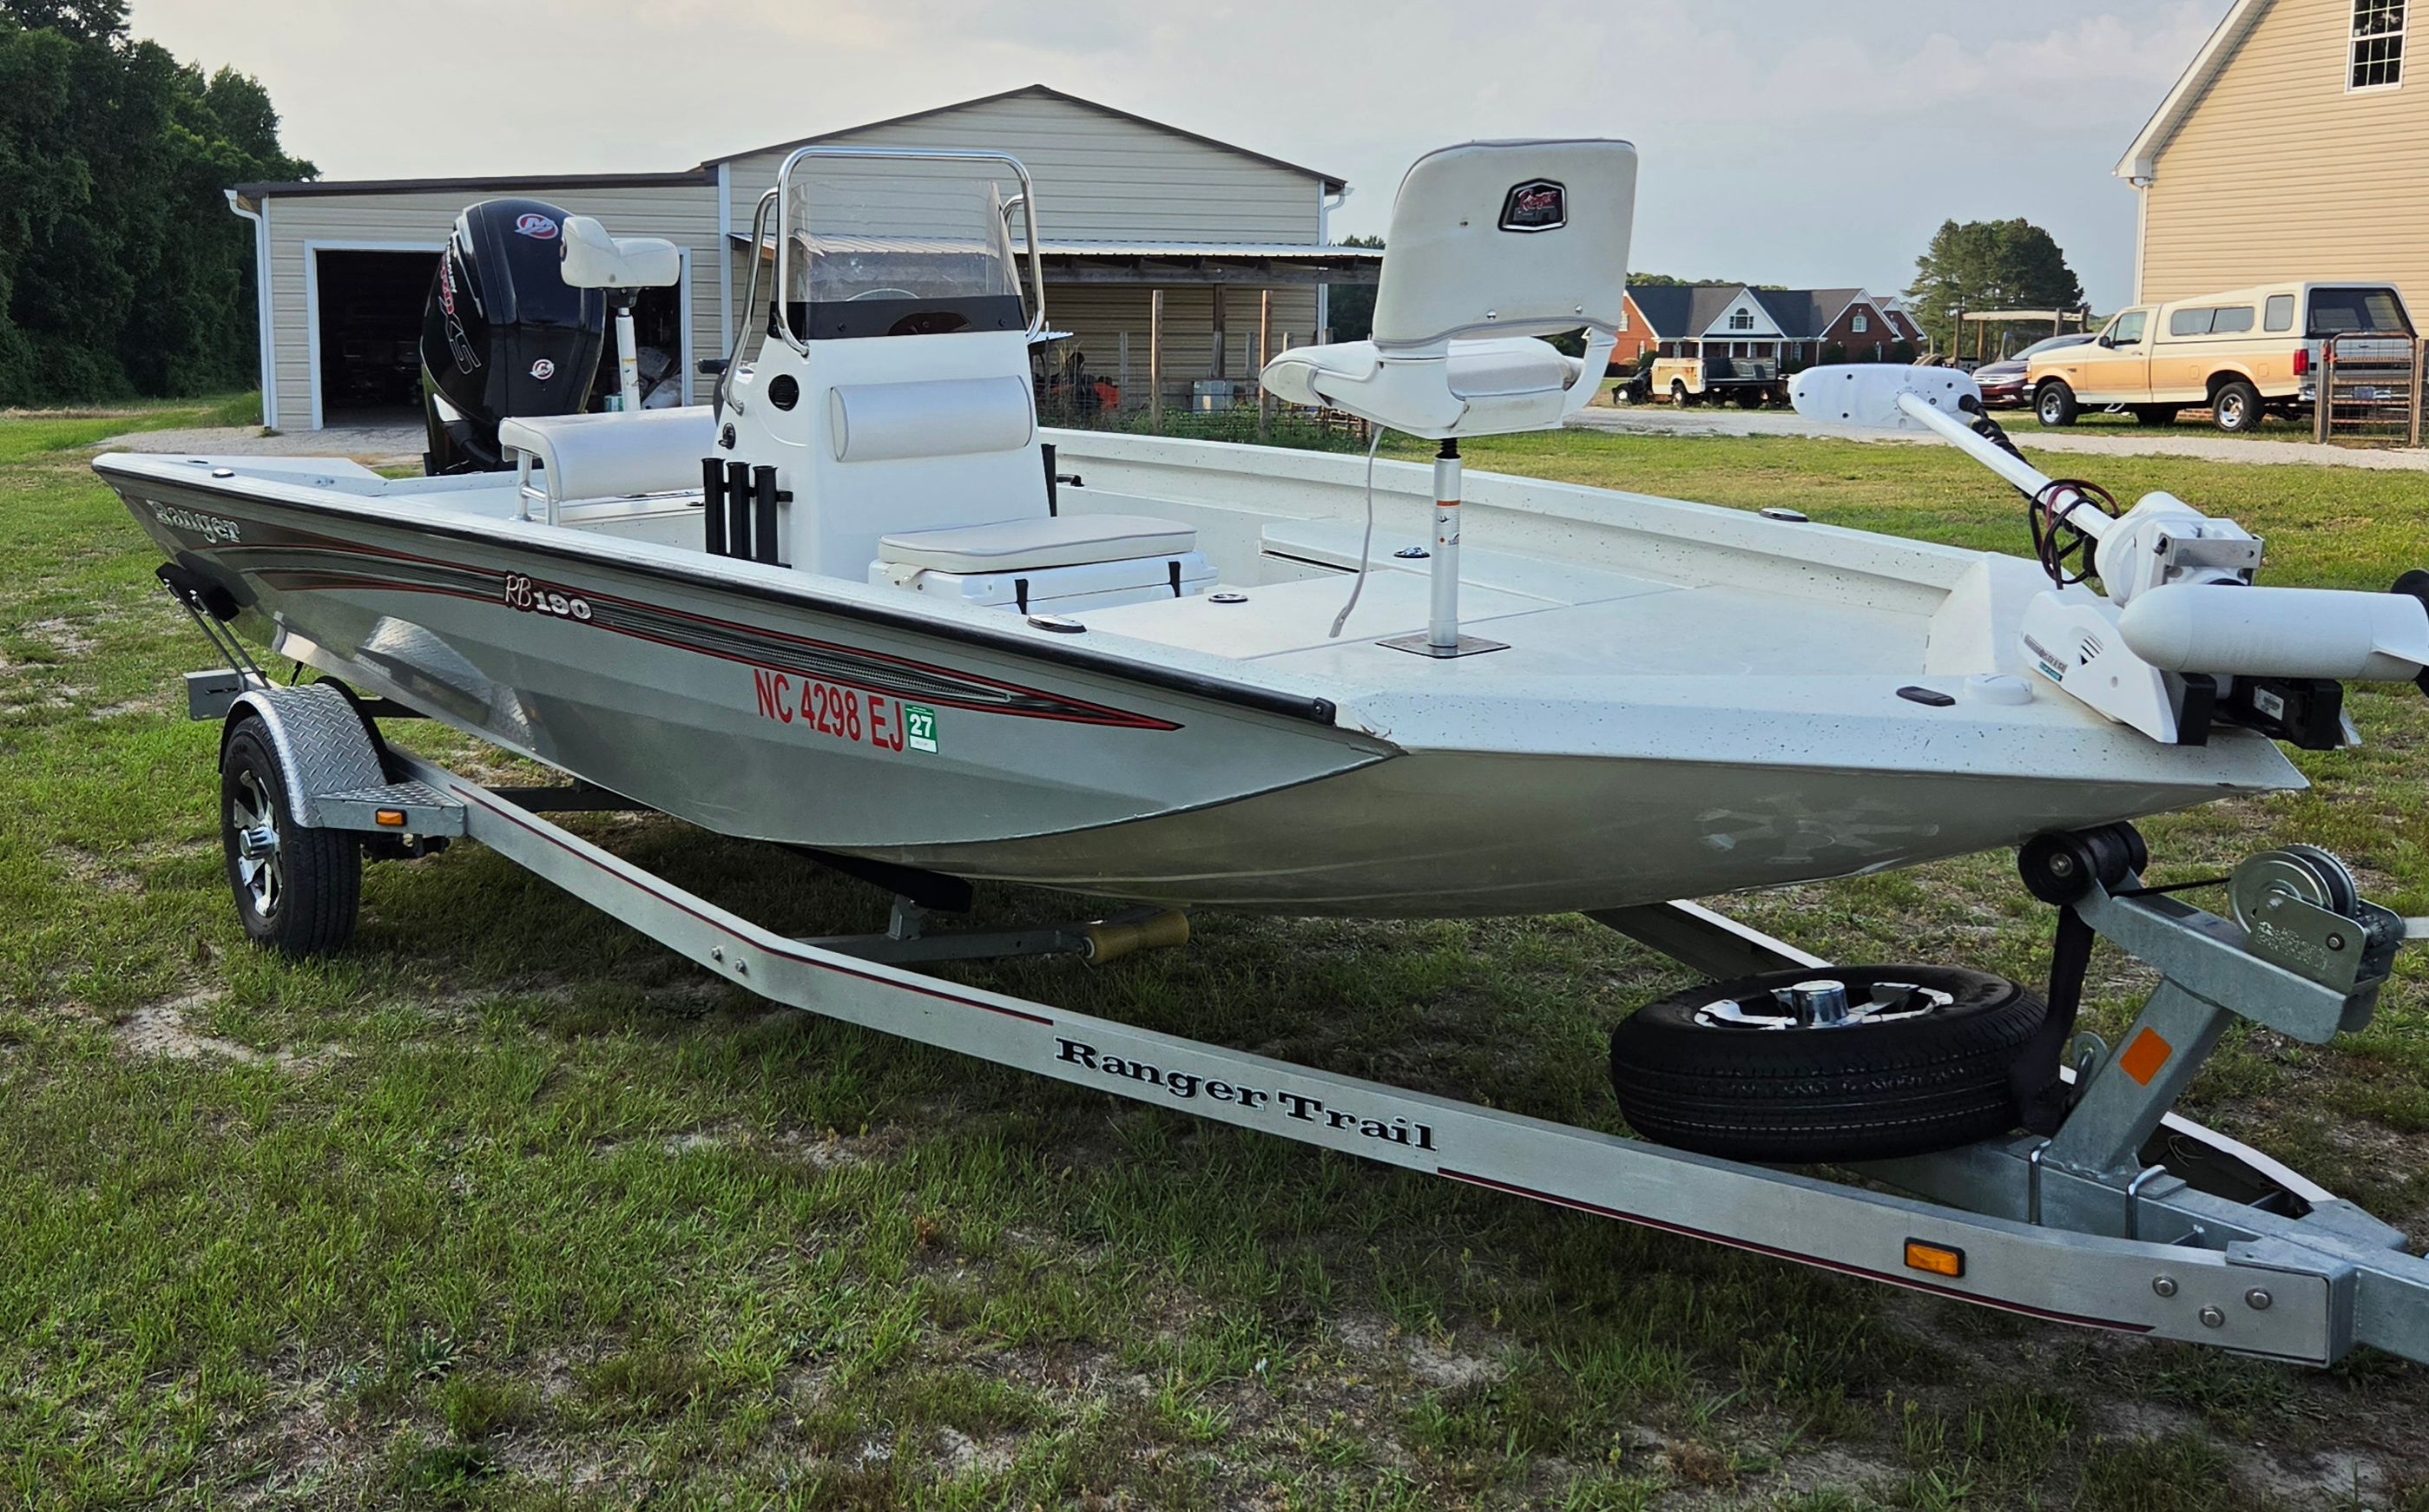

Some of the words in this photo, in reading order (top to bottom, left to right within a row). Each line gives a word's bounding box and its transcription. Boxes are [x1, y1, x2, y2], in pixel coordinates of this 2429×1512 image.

[146, 499, 240, 544] Ranger
[505, 575, 532, 607] RB
[533, 591, 592, 620] 190
[754, 668, 793, 724] NC
[800, 680, 861, 741] 4298
[868, 695, 904, 753] EJ
[909, 713, 933, 738] 27
[1054, 1037, 1268, 1109] Ranger
[1277, 1091, 1438, 1153] Trail
